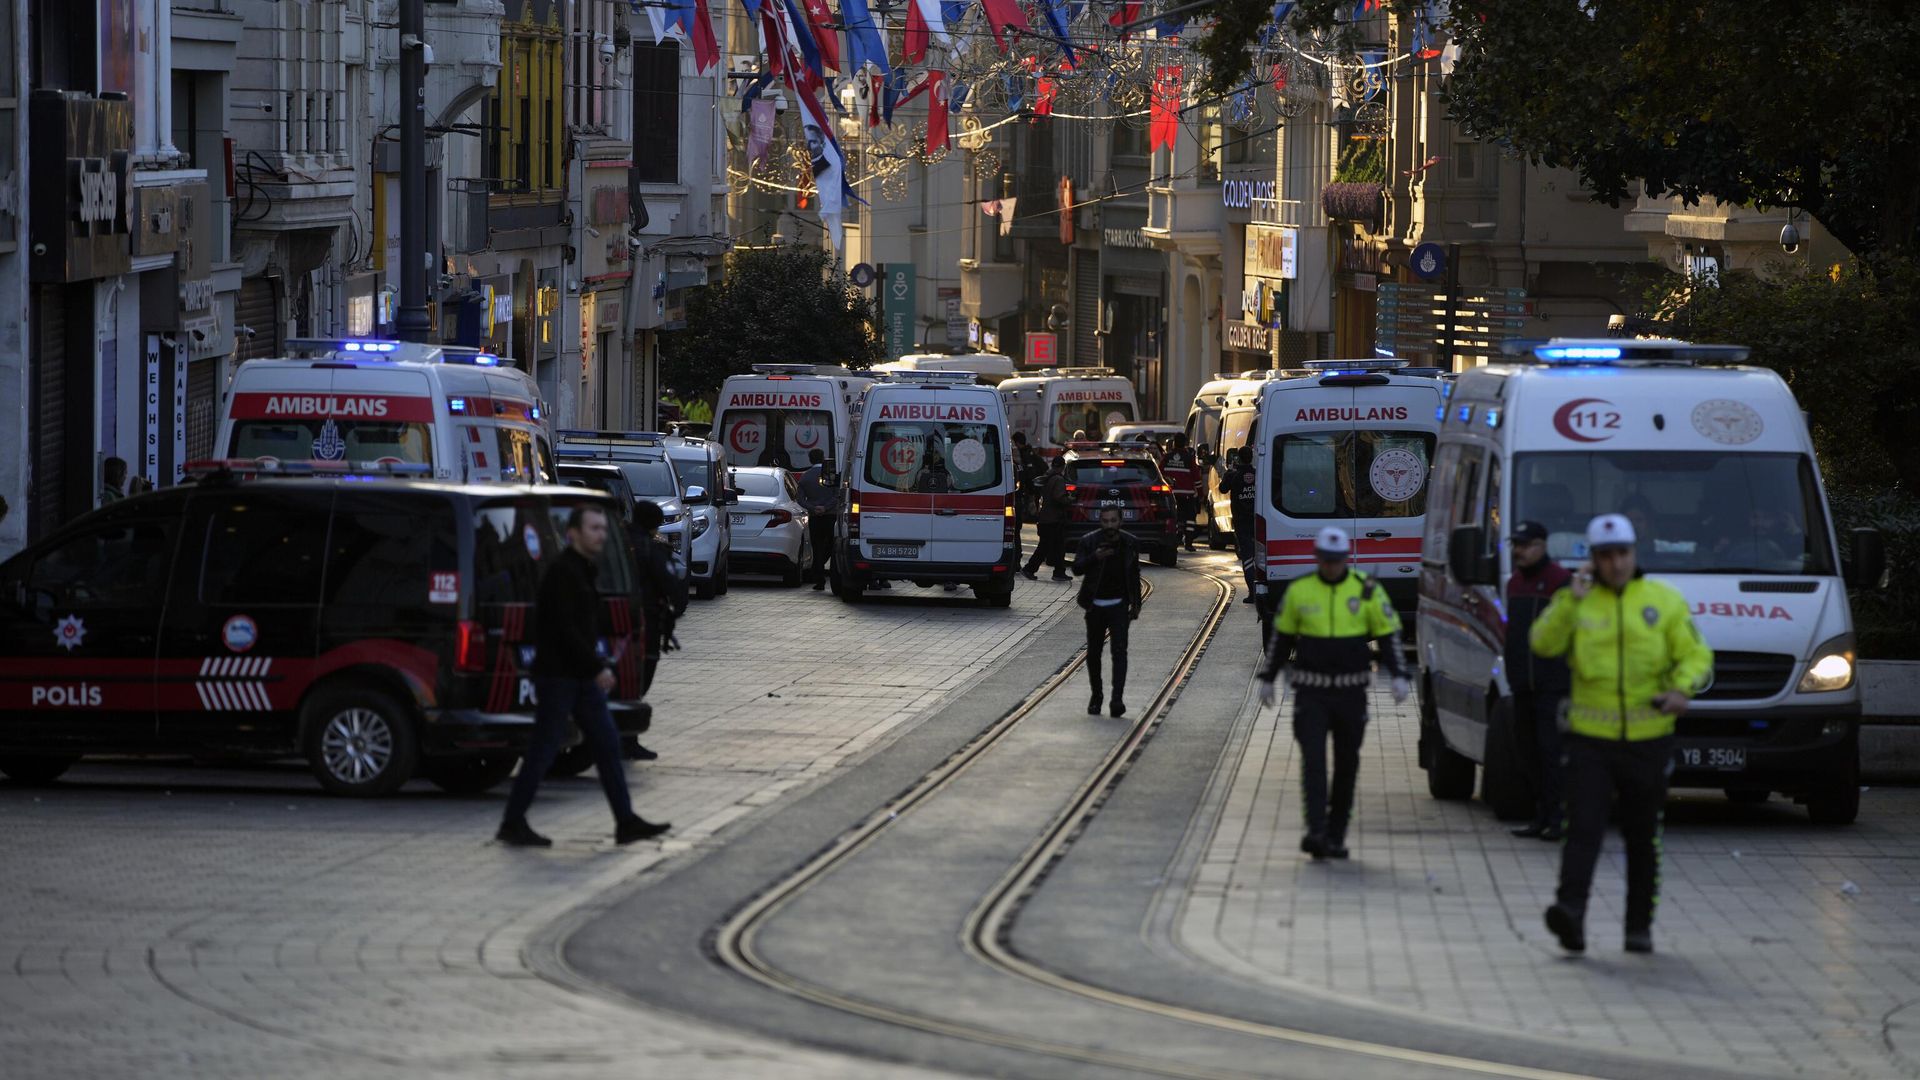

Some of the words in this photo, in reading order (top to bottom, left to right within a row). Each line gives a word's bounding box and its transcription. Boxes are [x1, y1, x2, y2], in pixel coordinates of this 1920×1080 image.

[1223, 180, 1252, 208] GOLDEN
[1256, 181, 1275, 209] ROSE
[1104, 228, 1135, 247] STARBUCKS
[1136, 230, 1154, 248] COFF
[1229, 326, 1250, 348] GOLDEN
[1252, 328, 1267, 350] ROSE
[1033, 340, 1049, 357] E
[176, 343, 184, 441] CHANGE
[730, 394, 821, 407] AMBULANS
[1057, 391, 1122, 400] AMBULANS
[265, 396, 388, 416] AMBULANS
[879, 405, 986, 421] AMBULANS
[1295, 407, 1408, 422] AMBULANS
[148, 353, 158, 486] WECHSEL
[1570, 411, 1622, 429] 112
[738, 431, 759, 443] 112
[891, 449, 915, 464] 112
[876, 547, 886, 555] 34
[898, 547, 917, 555] 5720
[433, 573, 456, 591] 112
[31, 681, 102, 706] POLİS
[1708, 749, 1744, 766] 3504
